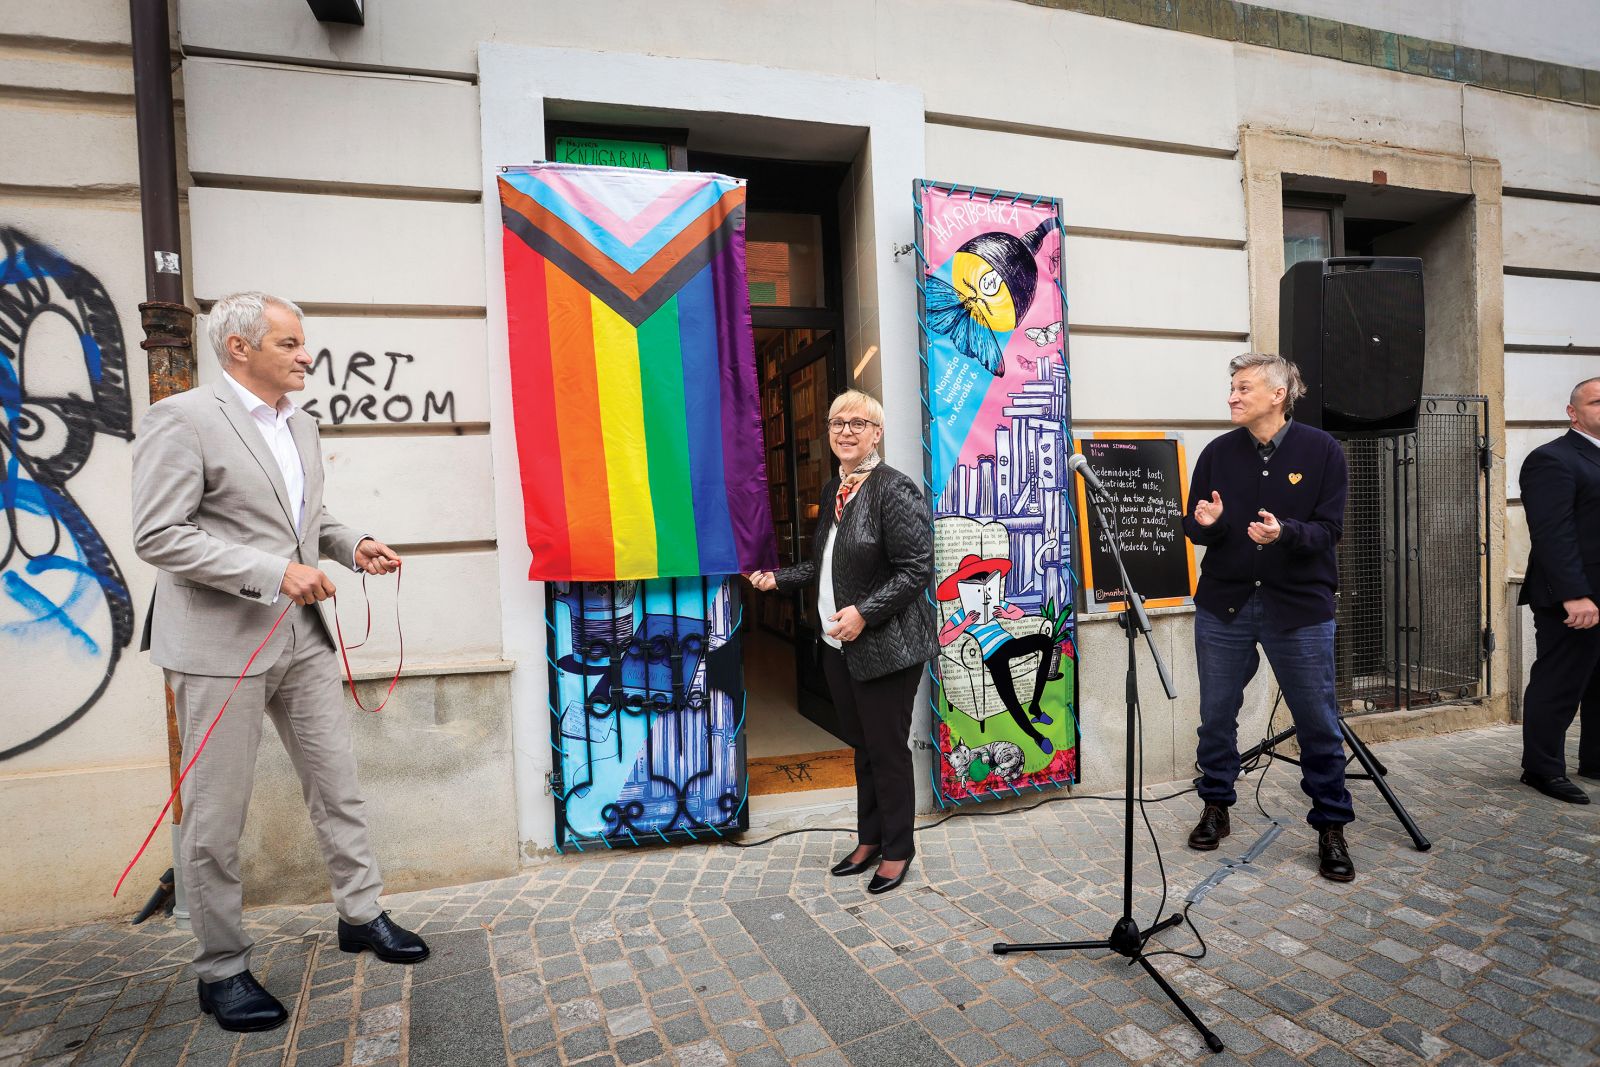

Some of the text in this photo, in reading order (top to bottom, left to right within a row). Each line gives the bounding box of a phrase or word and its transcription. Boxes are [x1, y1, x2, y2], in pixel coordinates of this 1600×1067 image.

[565, 148, 652, 169] KNJIGARNA
[926, 202, 1019, 245] MARIBORKA
[934, 356, 959, 395] Največja
[943, 363, 969, 404] knjigarna
[947, 414, 957, 426] na
[952, 380, 974, 413] Koroški
